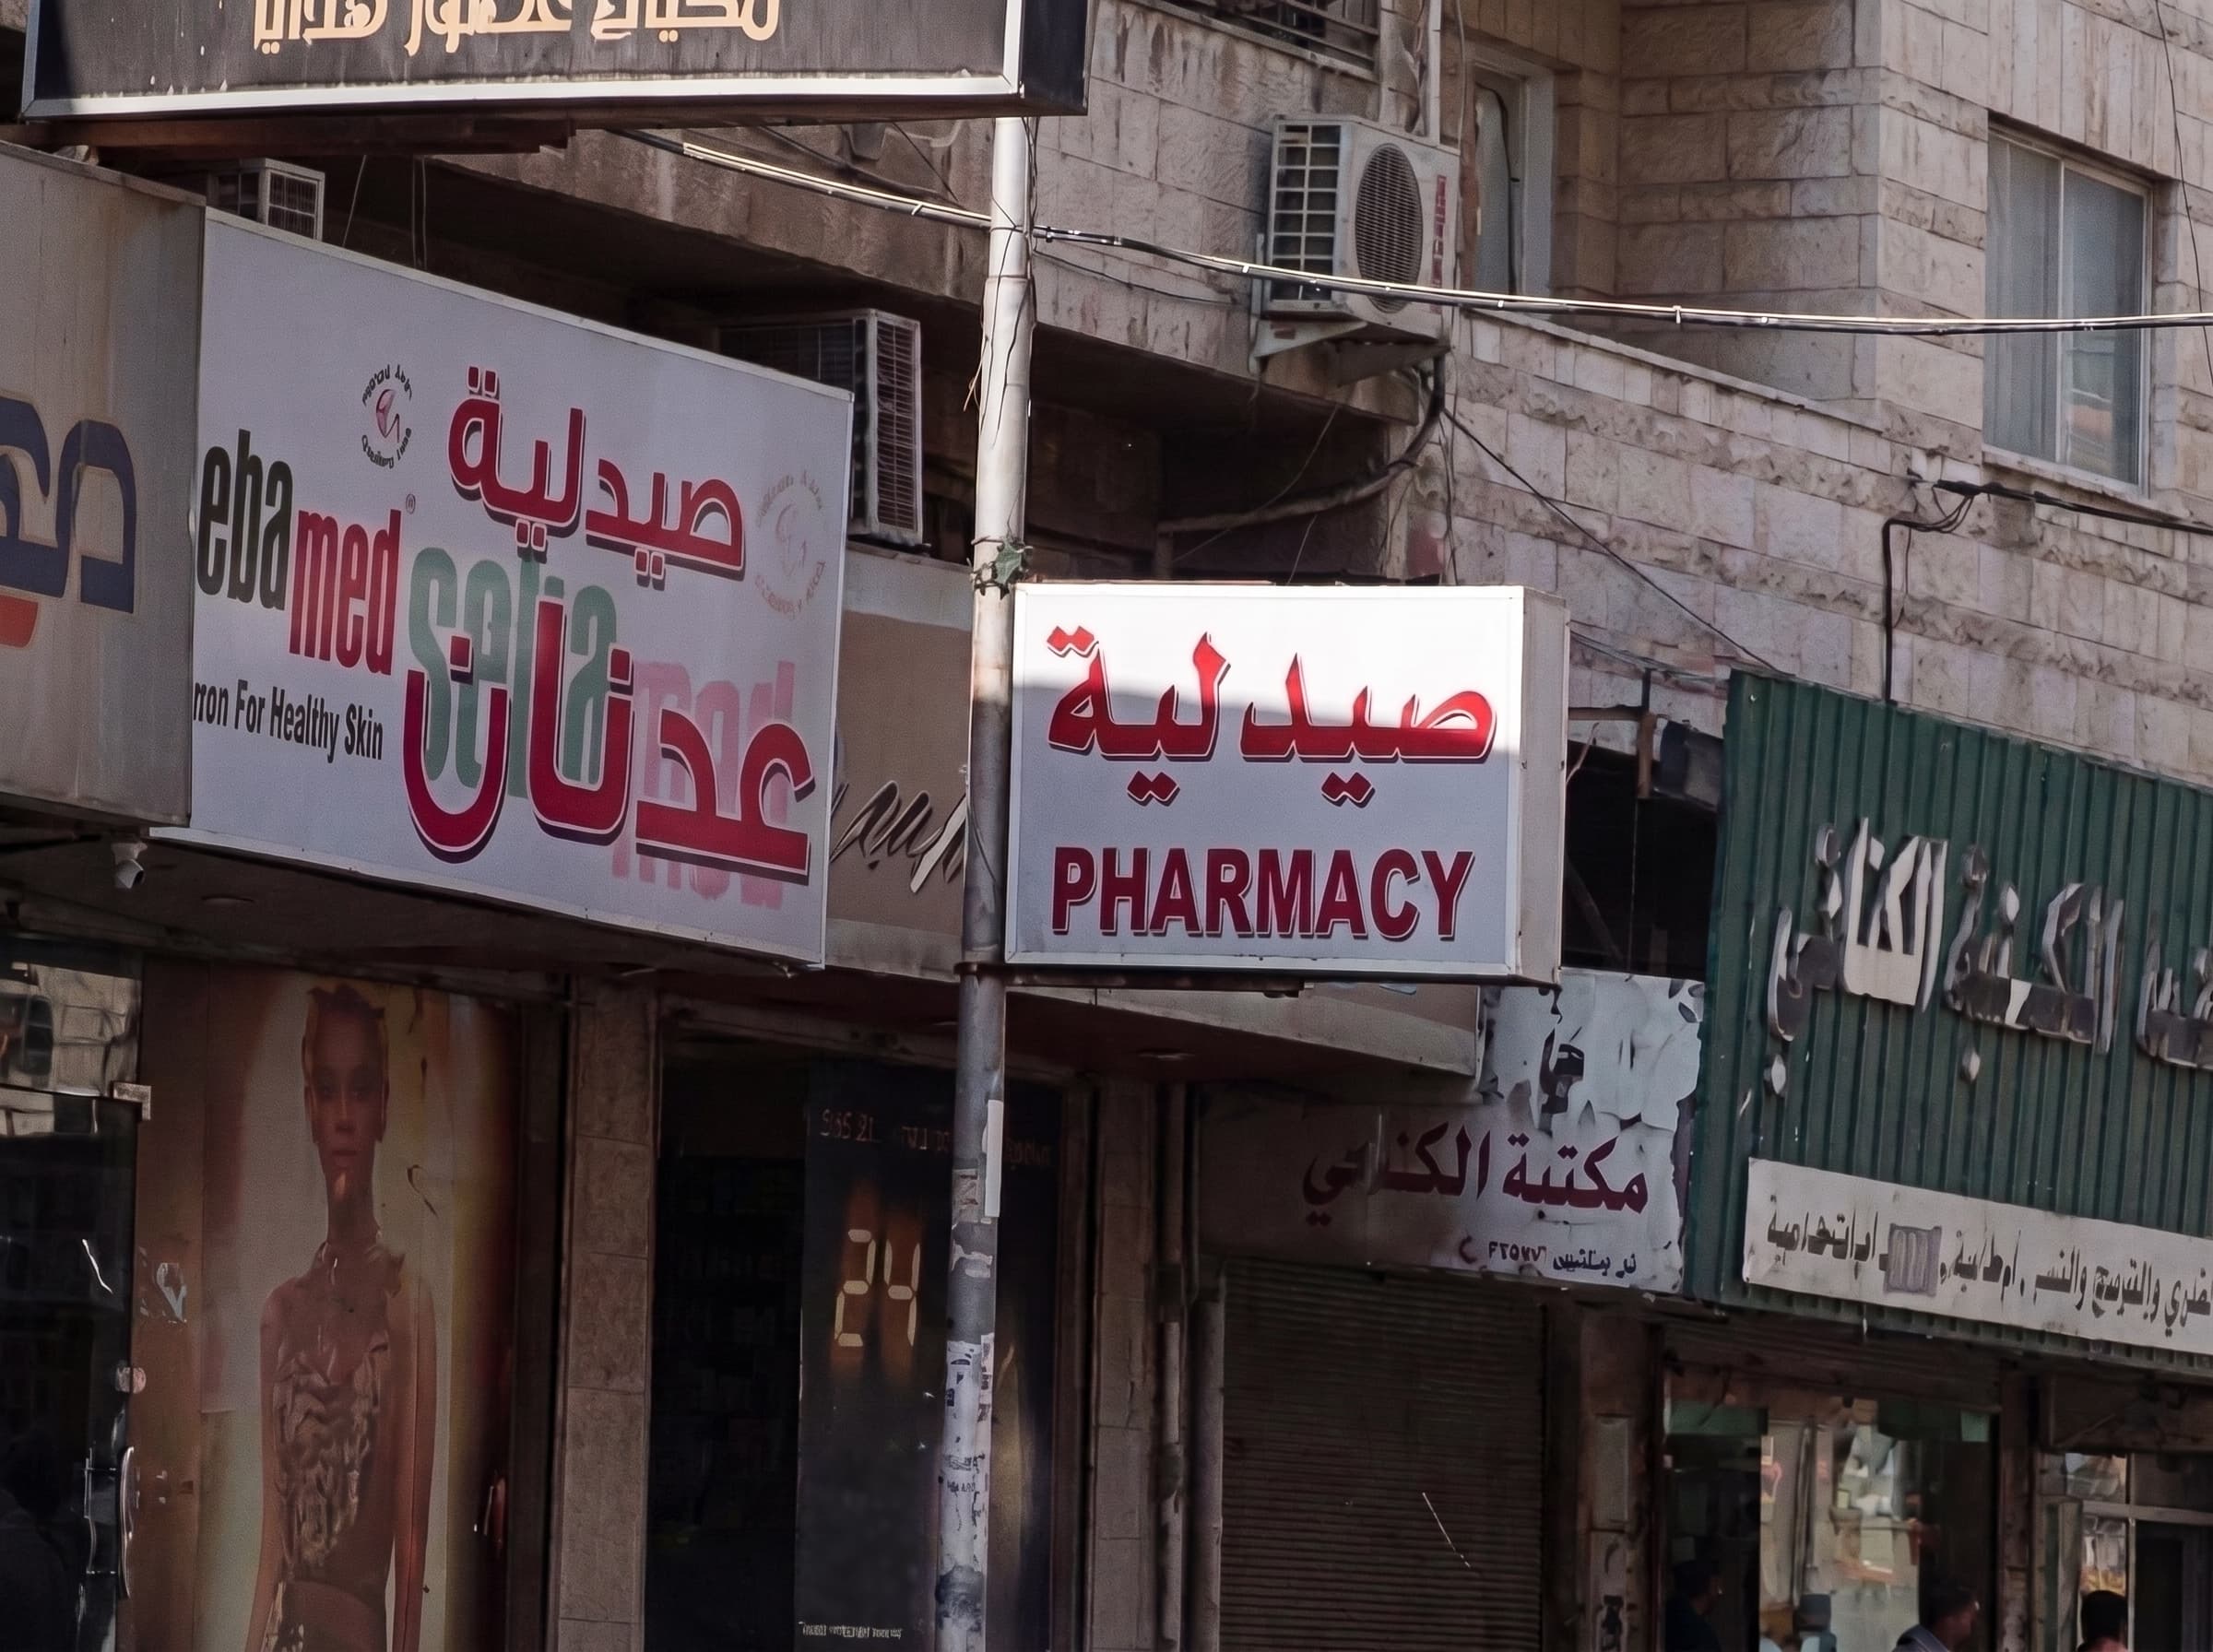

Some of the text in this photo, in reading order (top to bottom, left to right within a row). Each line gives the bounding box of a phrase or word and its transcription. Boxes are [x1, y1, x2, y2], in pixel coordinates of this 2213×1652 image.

[447, 365, 745, 592] صيدلية
[234, 678, 266, 734] For
[270, 686, 339, 763] Healthy
[344, 703, 384, 761] Skin
[403, 595, 816, 887] عدنان
[1047, 626, 1497, 807] صيدلية
[1052, 846, 1474, 941] PHARMACY
[1502, 1132, 1649, 1214] مكتبة
[834, 1228, 921, 1347] 24
